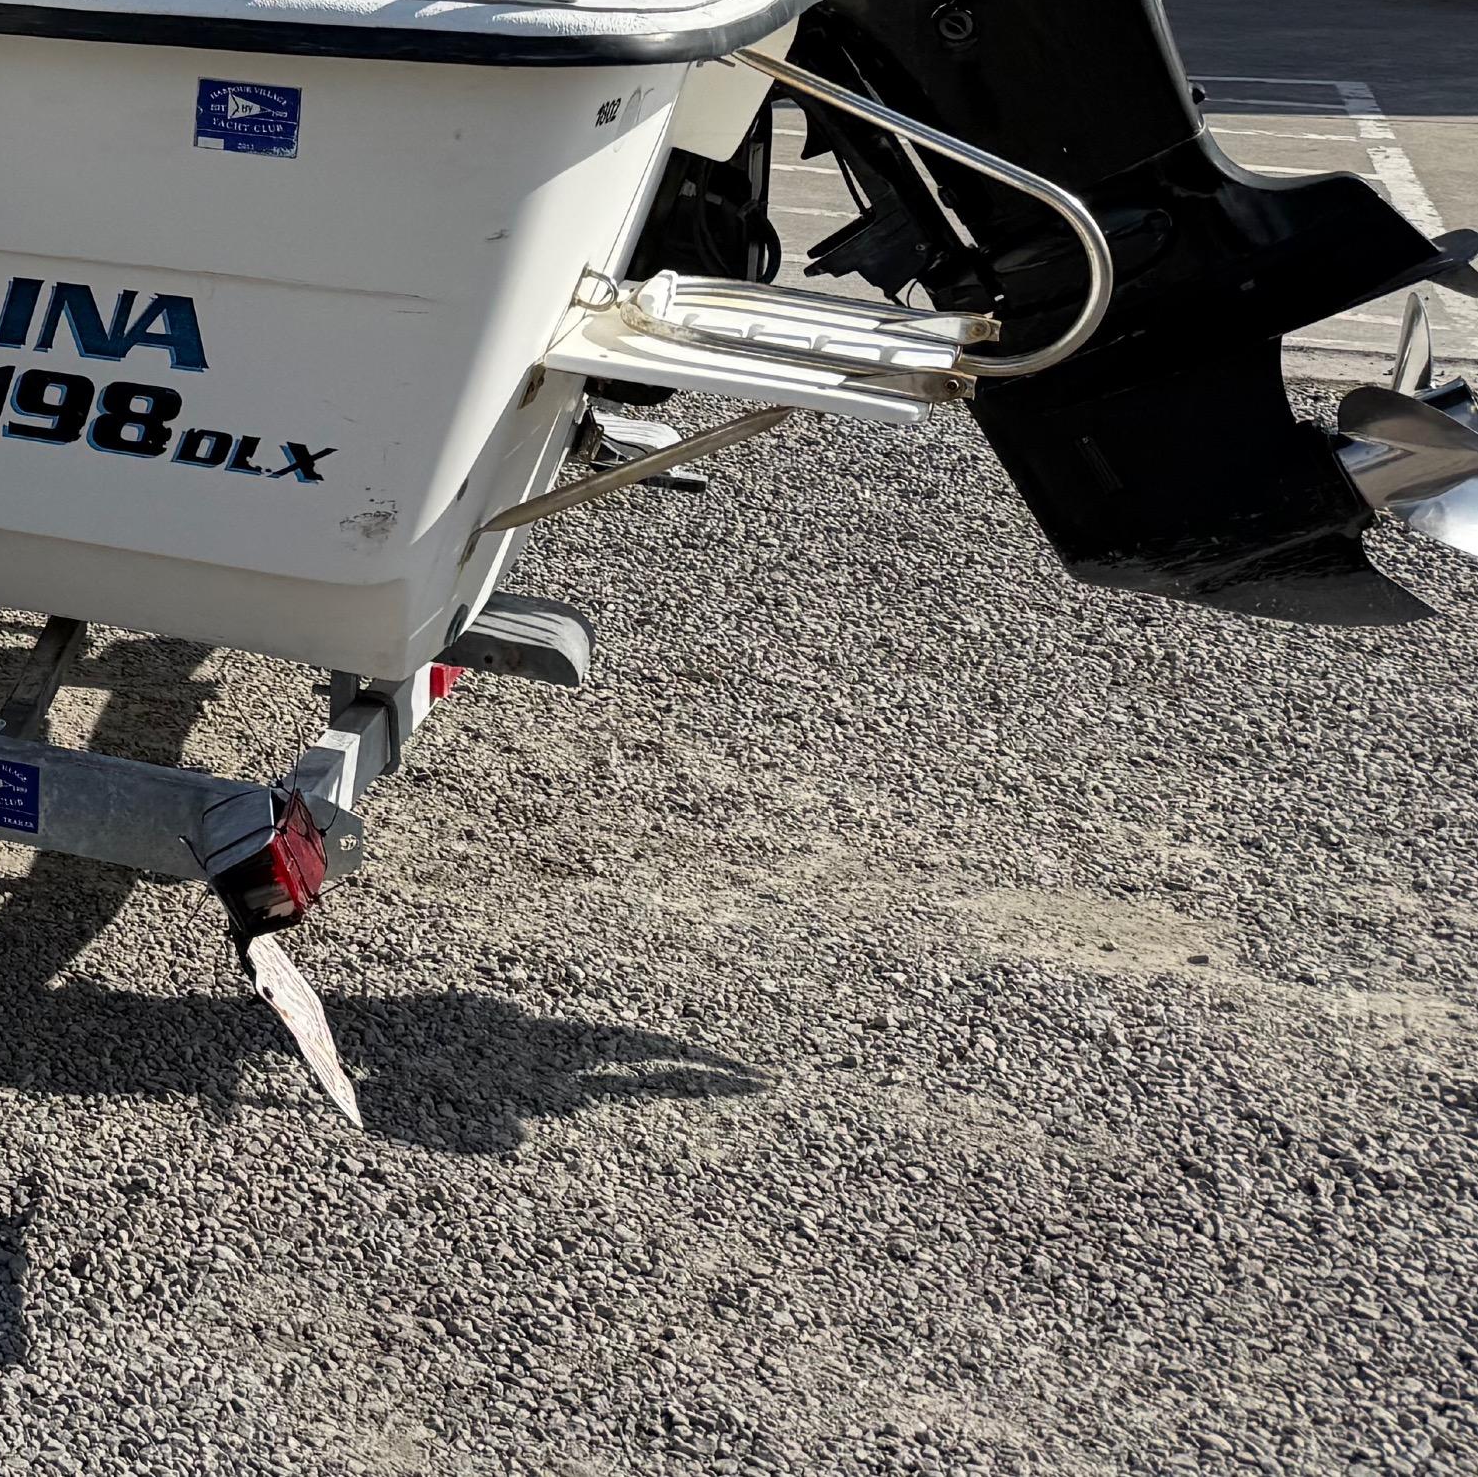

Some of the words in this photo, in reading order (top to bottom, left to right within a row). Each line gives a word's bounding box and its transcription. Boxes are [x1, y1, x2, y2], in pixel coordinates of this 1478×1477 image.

[254, 86, 287, 105] VILLAGE
[213, 117, 250, 132] YACHT
[253, 124, 284, 133] CLUB
